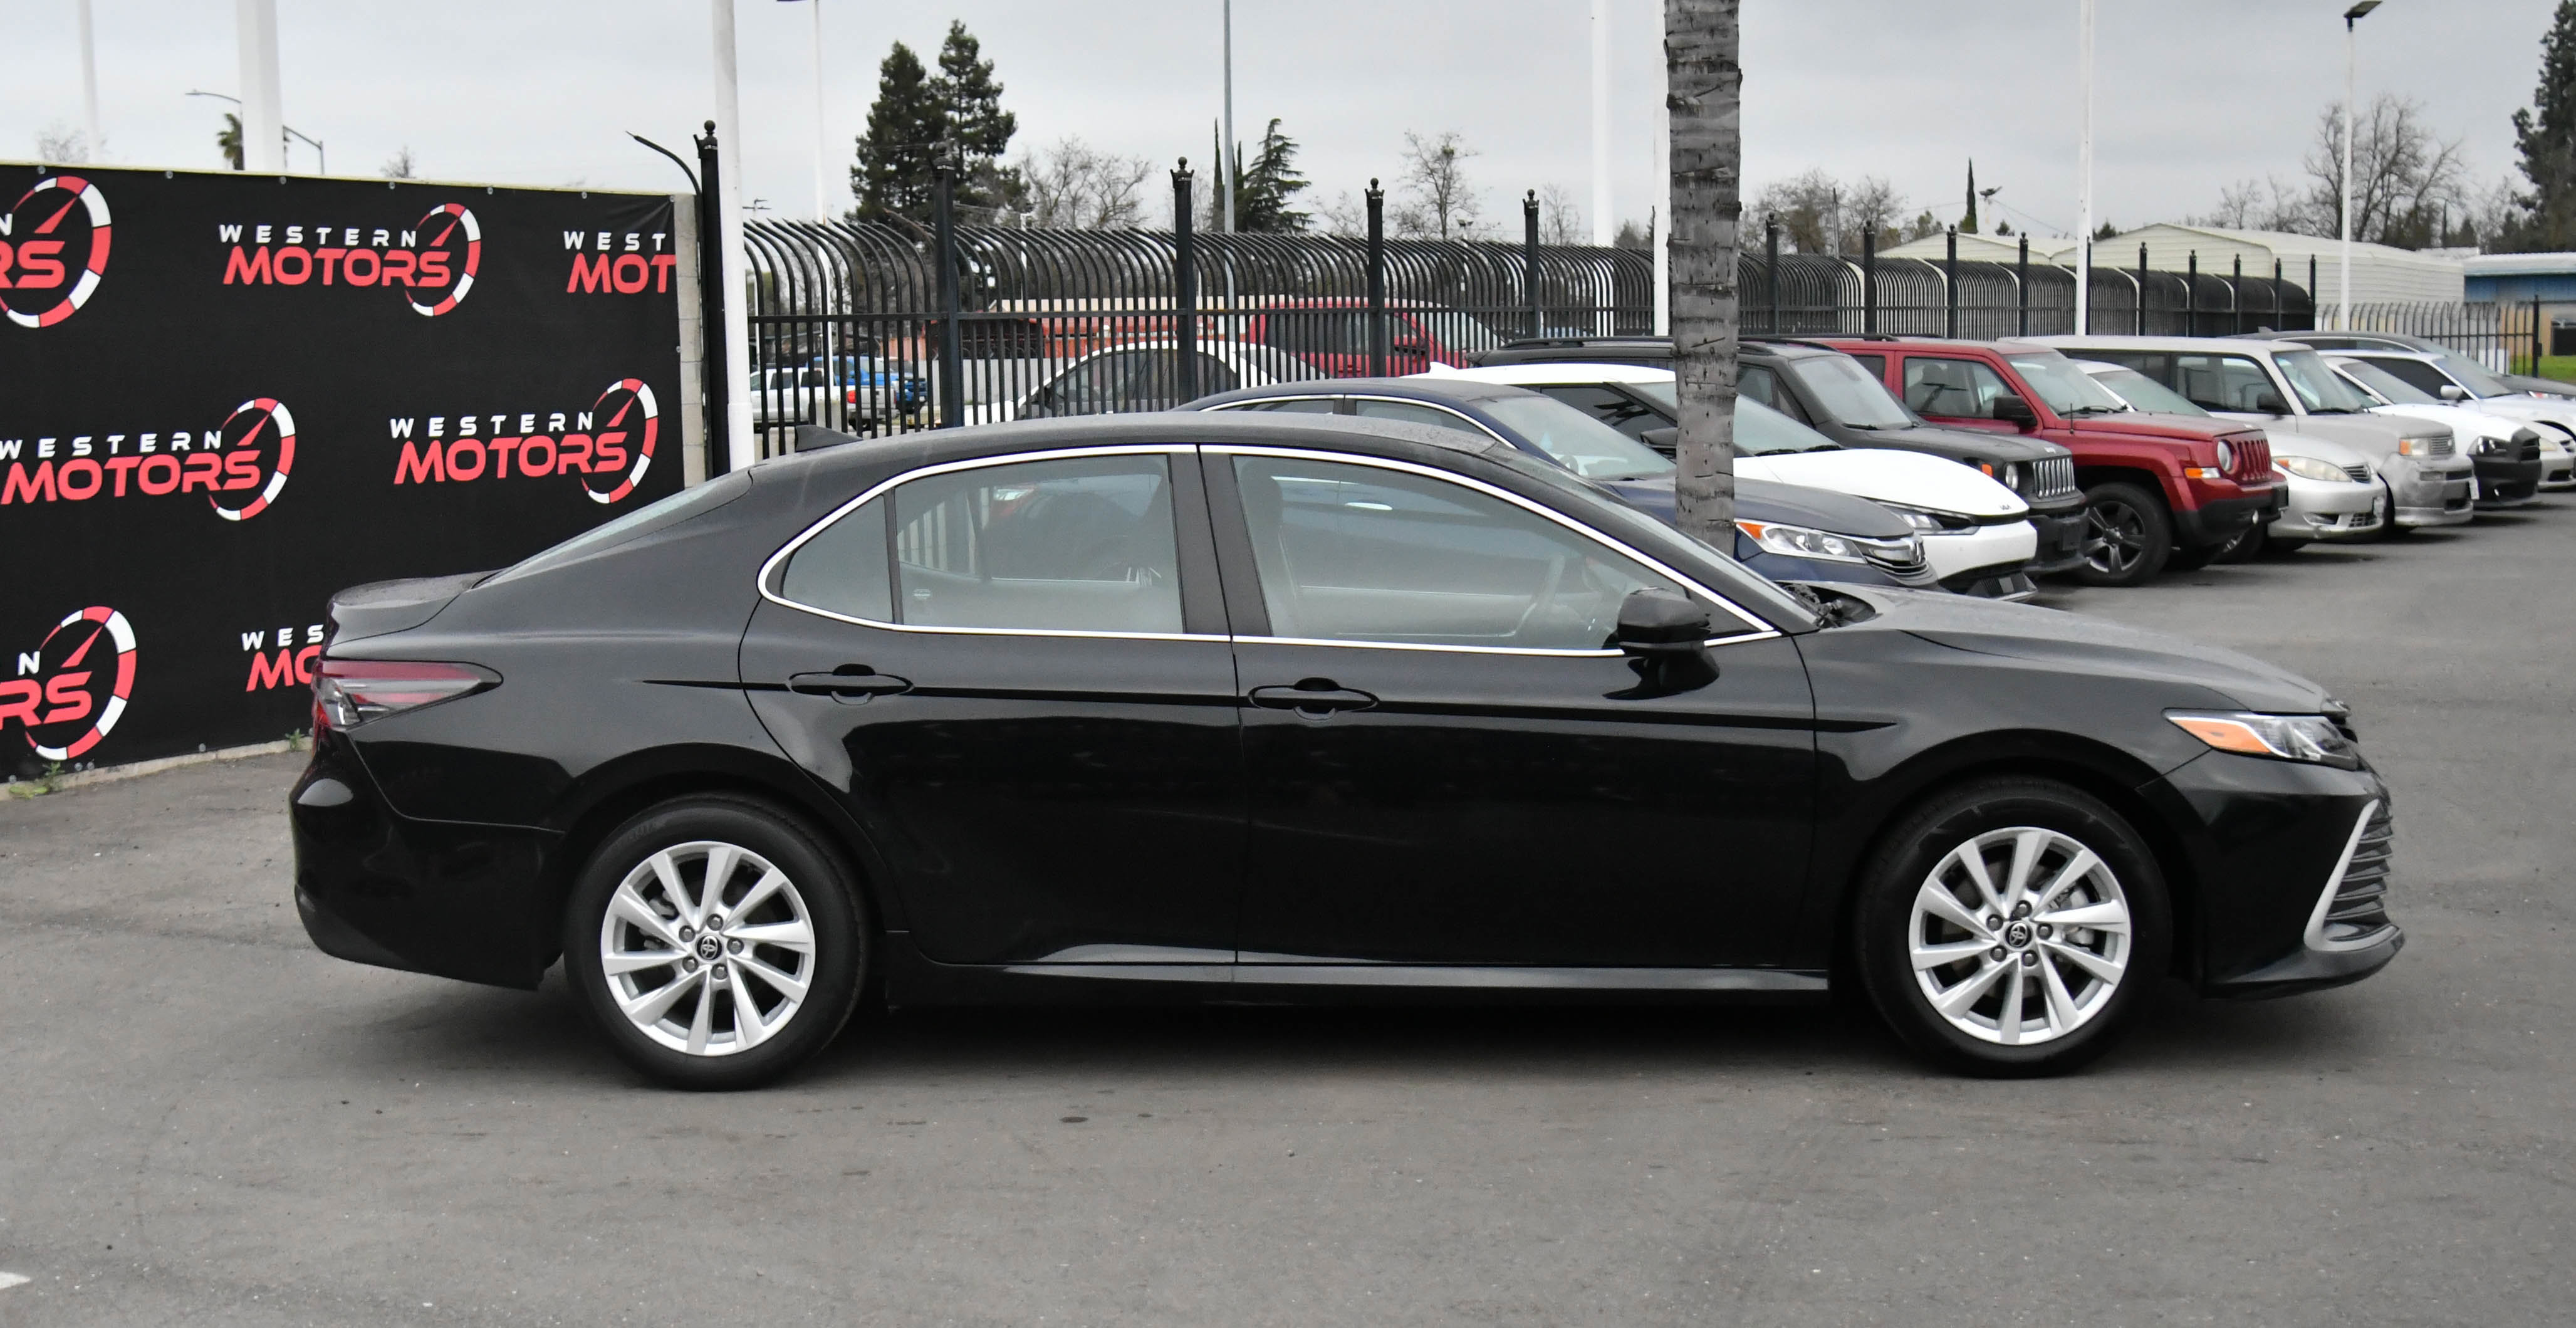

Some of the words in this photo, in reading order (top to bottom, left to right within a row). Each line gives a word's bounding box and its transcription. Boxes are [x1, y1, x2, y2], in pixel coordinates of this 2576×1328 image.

[219, 224, 417, 248] WESTERN
[223, 246, 451, 287] MOTORS
[390, 411, 593, 439] WESTERN
[0, 430, 222, 461] WESTERN
[394, 432, 627, 484] MOTORS
[1, 449, 261, 505] MOTORS
